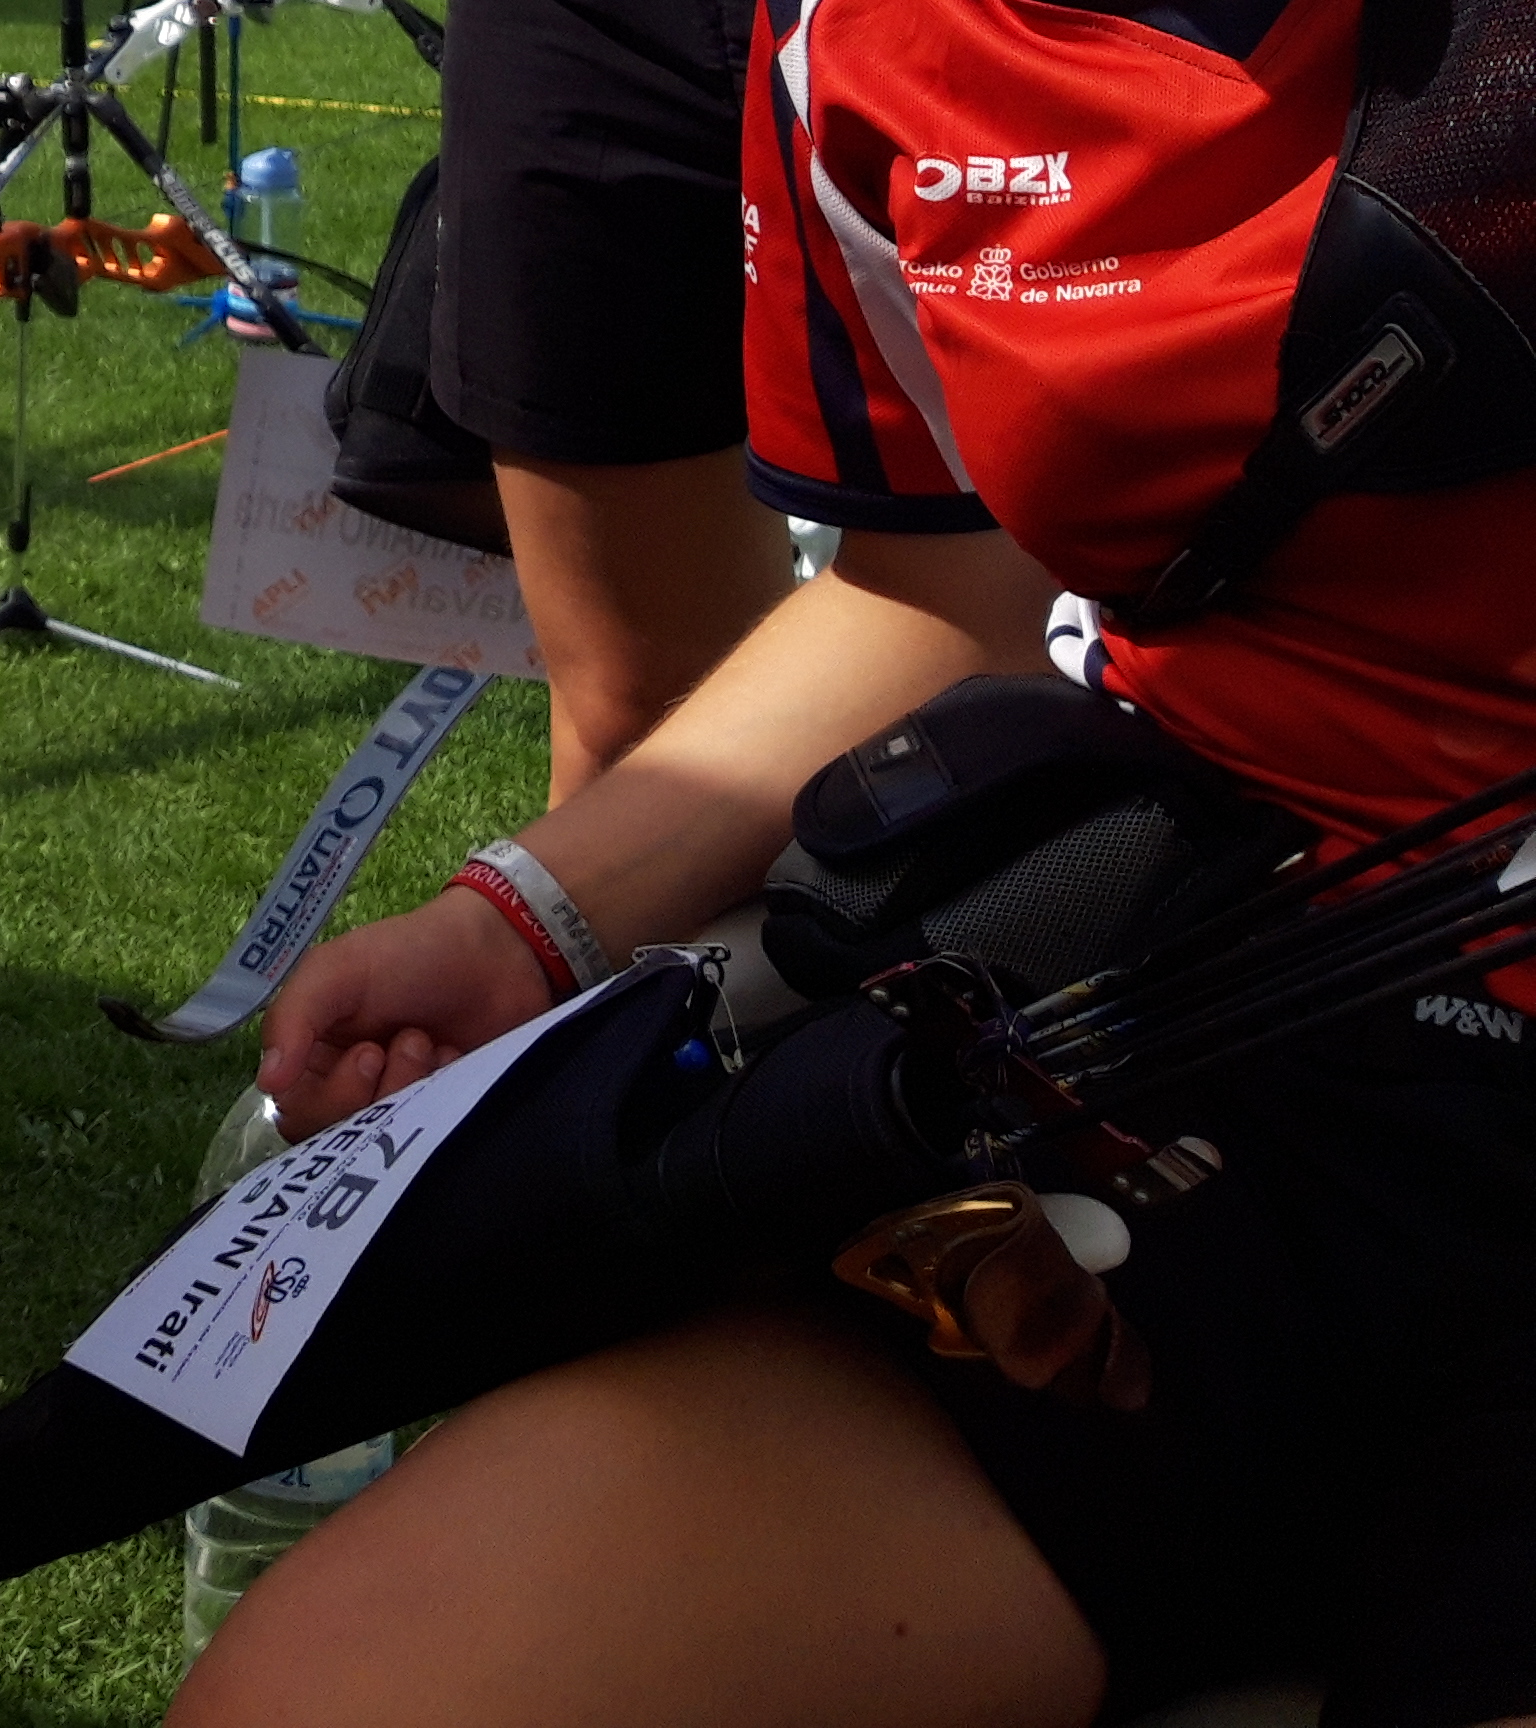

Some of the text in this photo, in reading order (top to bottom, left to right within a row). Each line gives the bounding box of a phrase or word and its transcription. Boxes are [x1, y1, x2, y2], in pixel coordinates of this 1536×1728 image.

[966, 151, 1072, 194] BZK
[1019, 288, 1049, 305] de
[1056, 278, 1142, 303] Navarra
[1020, 256, 1120, 282] Gobierno
[236, 776, 386, 973] QUATTRO
[1414, 993, 1524, 1043] W&W
[212, 1102, 395, 1271] BERIAIN
[263, 1256, 307, 1304] CSD
[134, 1278, 223, 1374] Irati
